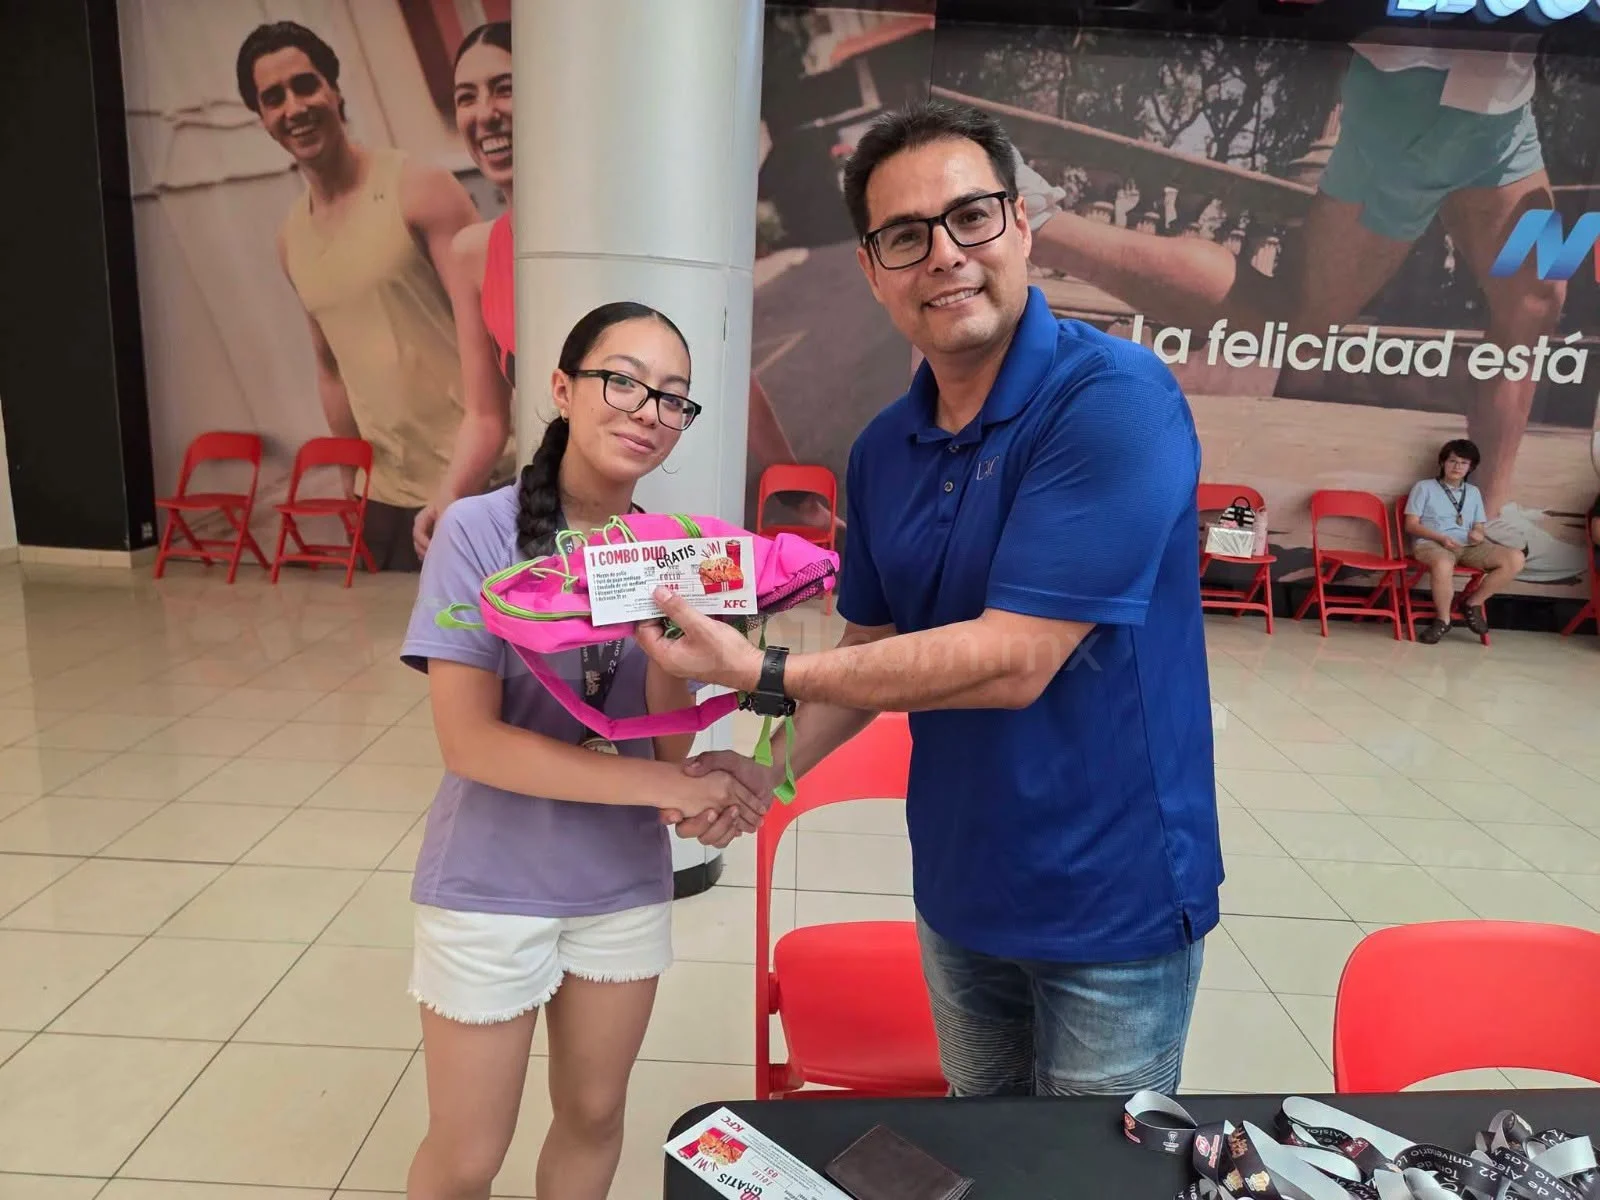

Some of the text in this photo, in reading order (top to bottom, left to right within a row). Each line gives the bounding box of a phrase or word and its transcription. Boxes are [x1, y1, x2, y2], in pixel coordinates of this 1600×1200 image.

[1206, 318, 1455, 377] felicidad
[1467, 331, 1589, 385] está
[599, 548, 639, 566] COMBO
[642, 545, 667, 562] DUO
[656, 544, 696, 569] GRATIS
[723, 600, 747, 609] KFC
[720, 1116, 744, 1132] KFC
[1479, 1165, 1498, 1181] 22
[717, 1173, 763, 1197] GRATIS
